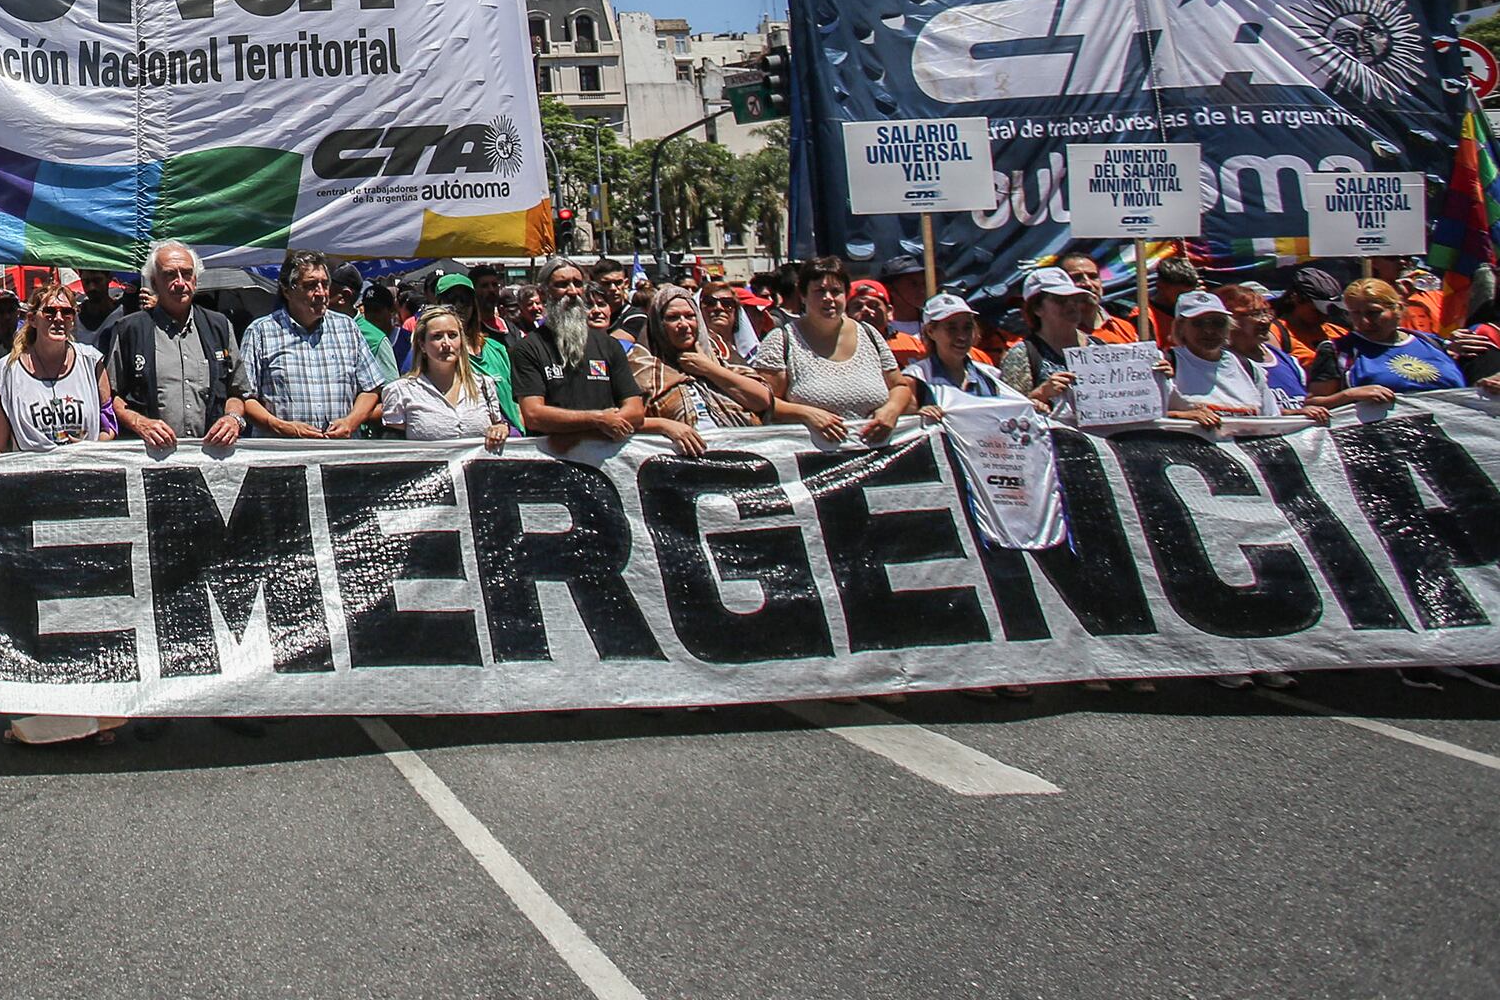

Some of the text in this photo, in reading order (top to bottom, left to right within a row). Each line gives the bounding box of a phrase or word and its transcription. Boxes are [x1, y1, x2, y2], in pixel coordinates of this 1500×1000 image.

[78, 37, 222, 87] Nacional
[228, 28, 400, 82] Territorial
[1021, 119, 1043, 139] de
[1194, 107, 1226, 126] de
[1231, 106, 1255, 124] la
[1262, 107, 1365, 128] argentina
[877, 123, 958, 145] SALARIO
[312, 124, 499, 179] CTA
[866, 142, 972, 164] UNIVERSAL
[1104, 150, 1167, 163] AUMENTO
[902, 162, 941, 182] YA!!
[1094, 163, 1177, 178] DEL SALARIO
[317, 185, 418, 197] central de trabajadores
[421, 179, 510, 201] autónoma
[1150, 178, 1182, 192] VITAL
[1336, 177, 1401, 194] SALARIO
[353, 193, 418, 204] de la argentina
[1111, 193, 1120, 207] Y
[1325, 195, 1411, 211] UNIVERSAL
[1355, 211, 1386, 229] YA!!
[30, 399, 84, 428] FeNaT
